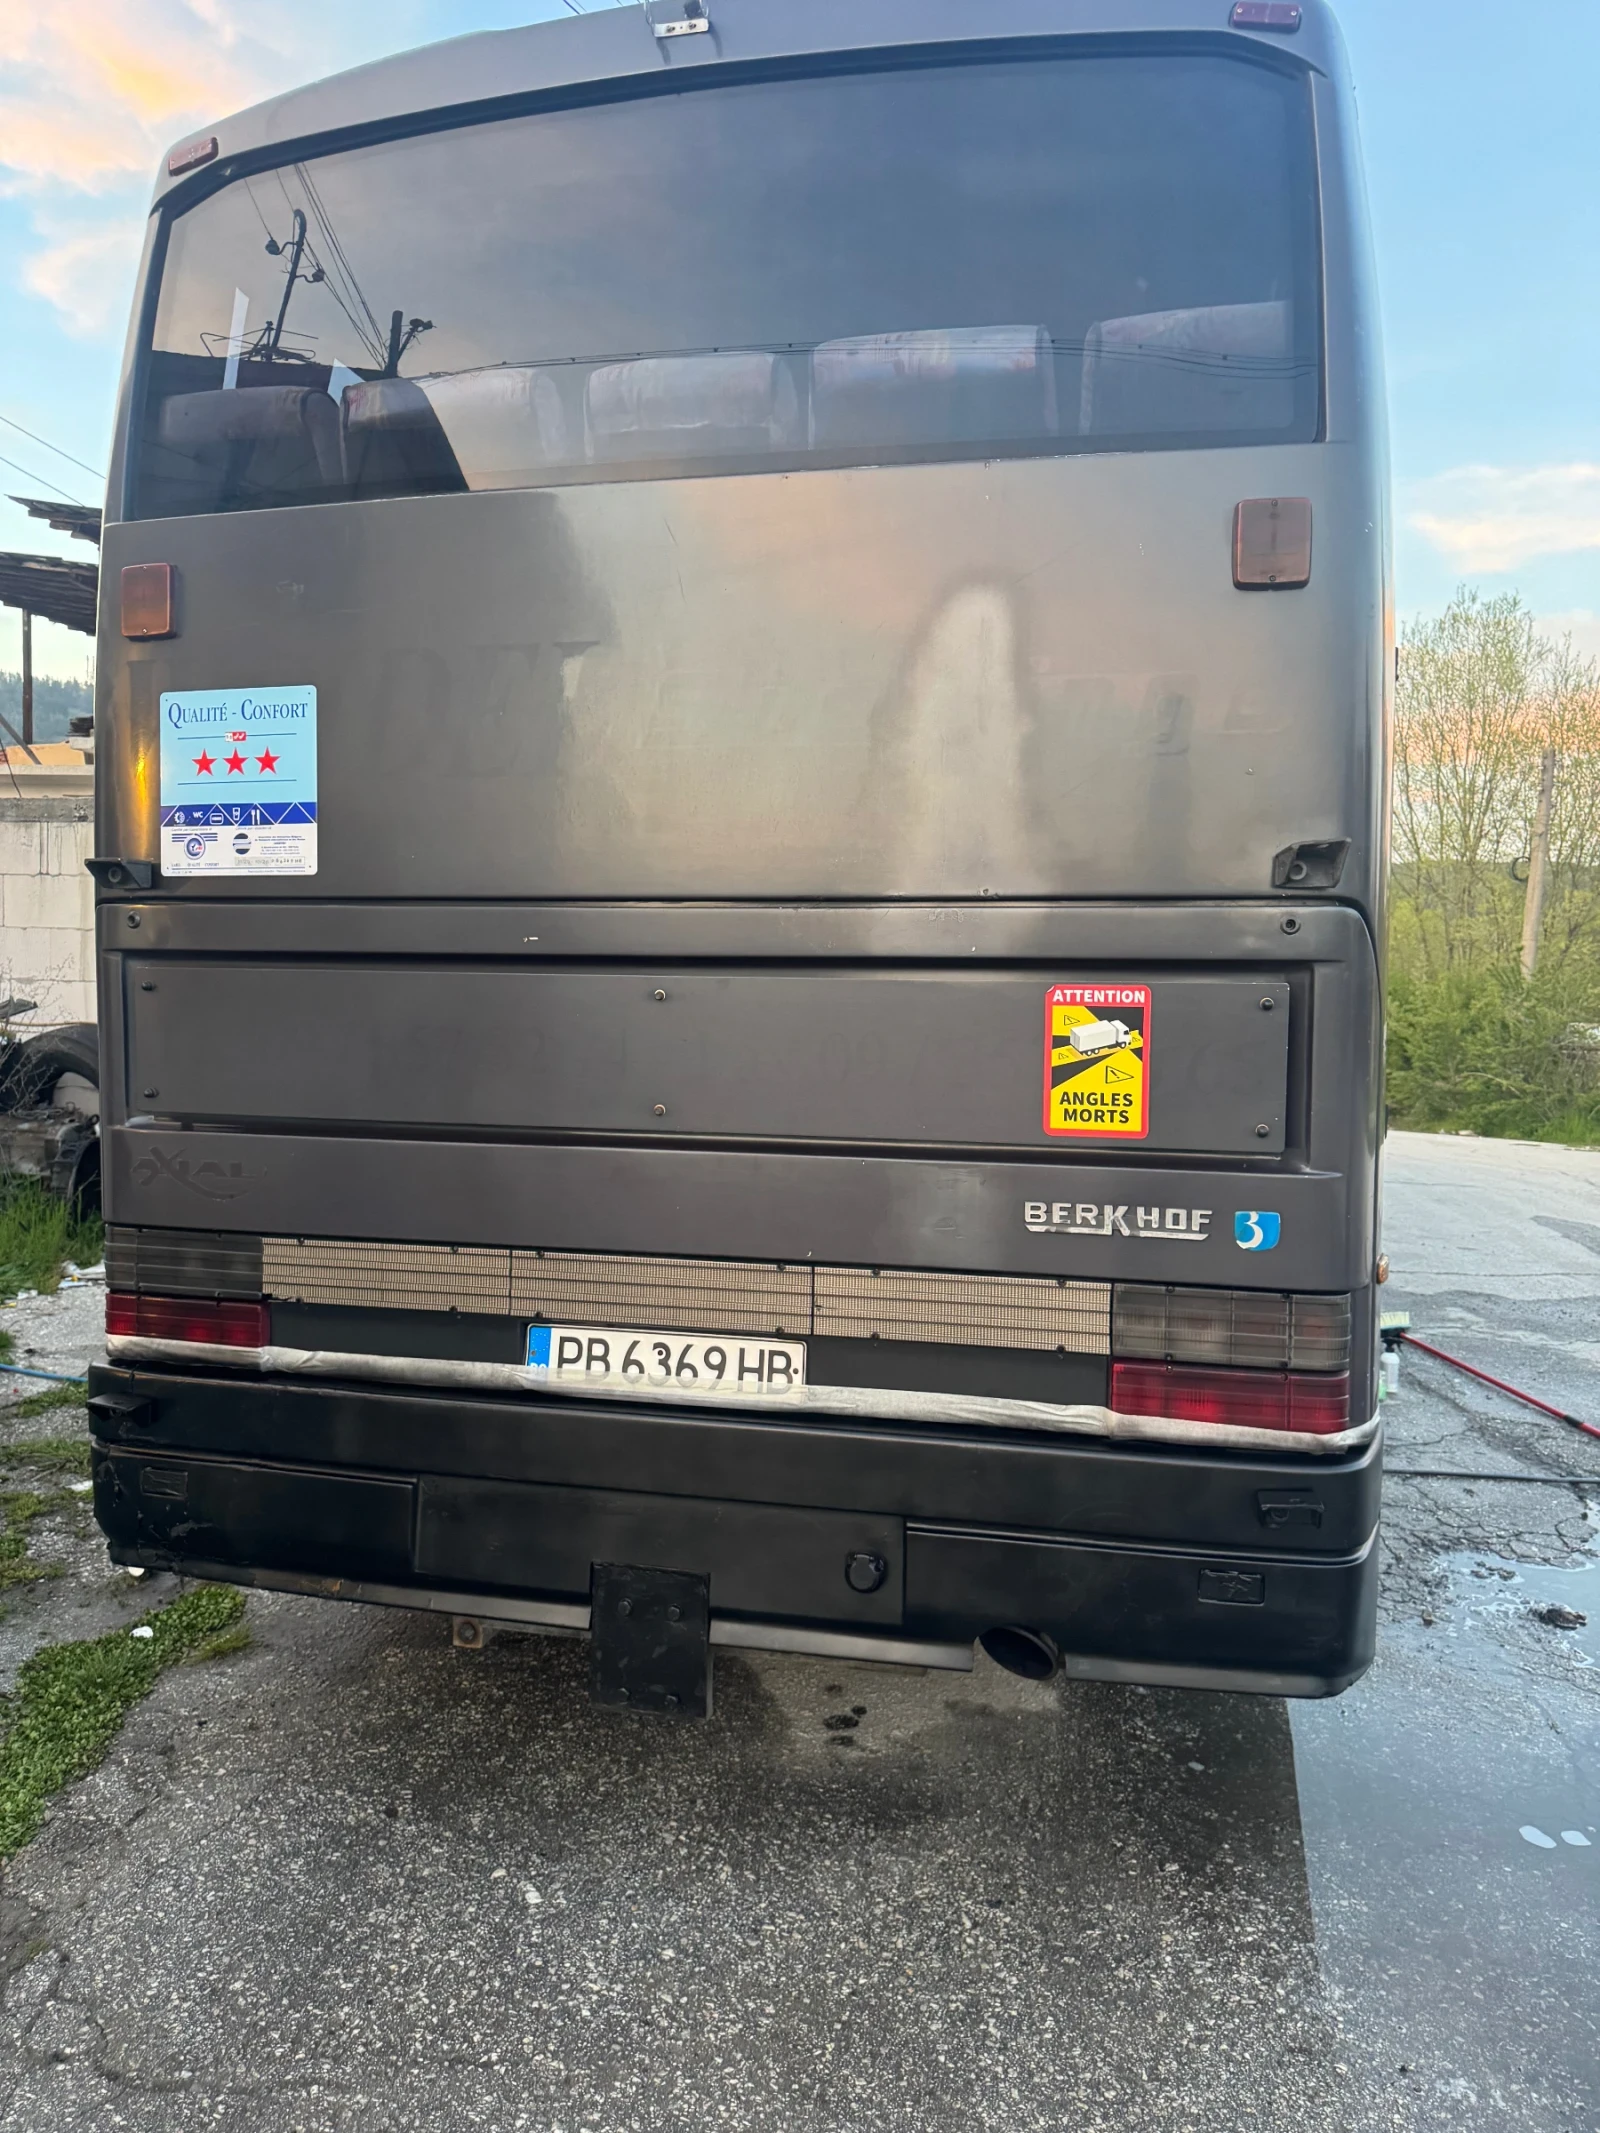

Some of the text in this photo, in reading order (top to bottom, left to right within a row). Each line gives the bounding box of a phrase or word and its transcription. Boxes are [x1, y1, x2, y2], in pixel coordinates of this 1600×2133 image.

[241, 699, 308, 721] CONFORT
[192, 811, 204, 819] WC
[1052, 989, 1146, 1004] ATTENTION
[1059, 1091, 1133, 1107] ANGLES
[1063, 1108, 1130, 1124] MORTS
[1024, 1201, 1213, 1238] BERKHOF
[556, 1335, 794, 1395] PB 6369 HB
